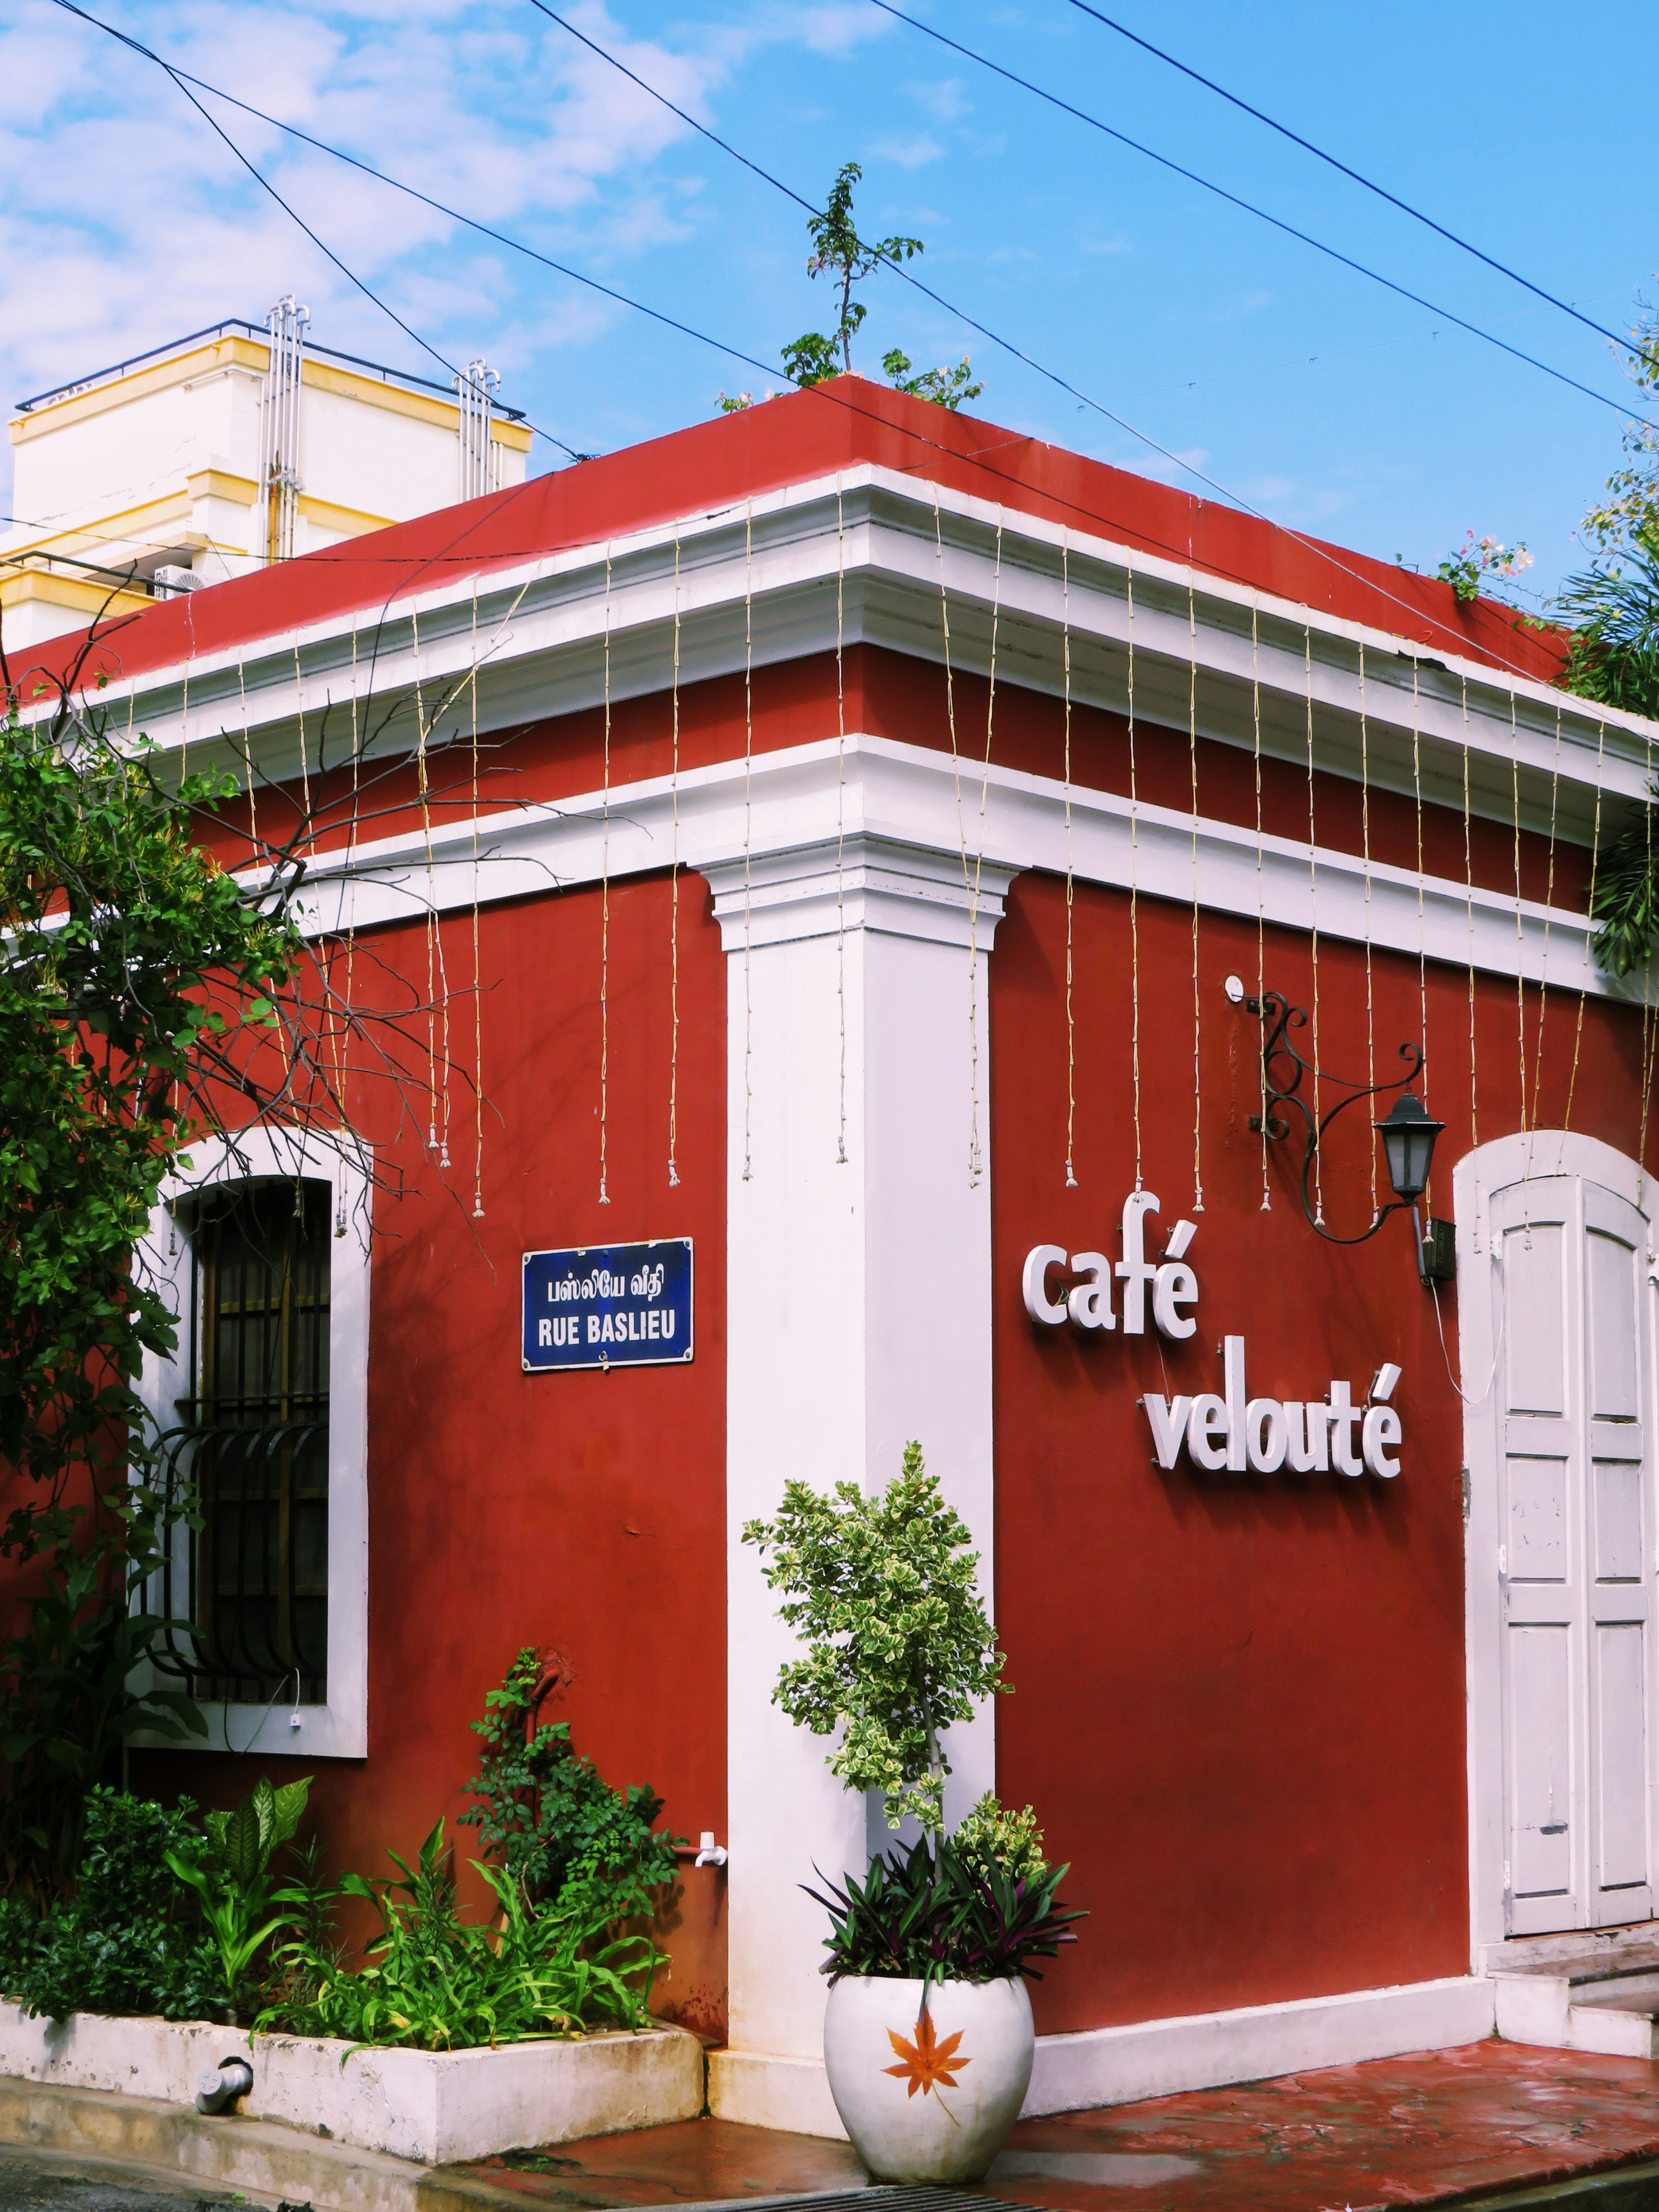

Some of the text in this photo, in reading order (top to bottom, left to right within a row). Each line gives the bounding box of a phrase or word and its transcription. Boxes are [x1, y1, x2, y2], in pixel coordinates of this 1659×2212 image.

[631, 1263, 664, 1301] வீதி
[1022, 1190, 1199, 1339] café
[539, 1309, 675, 1347] RUE BASLIEU
[1143, 1335, 1402, 1479] velouté
